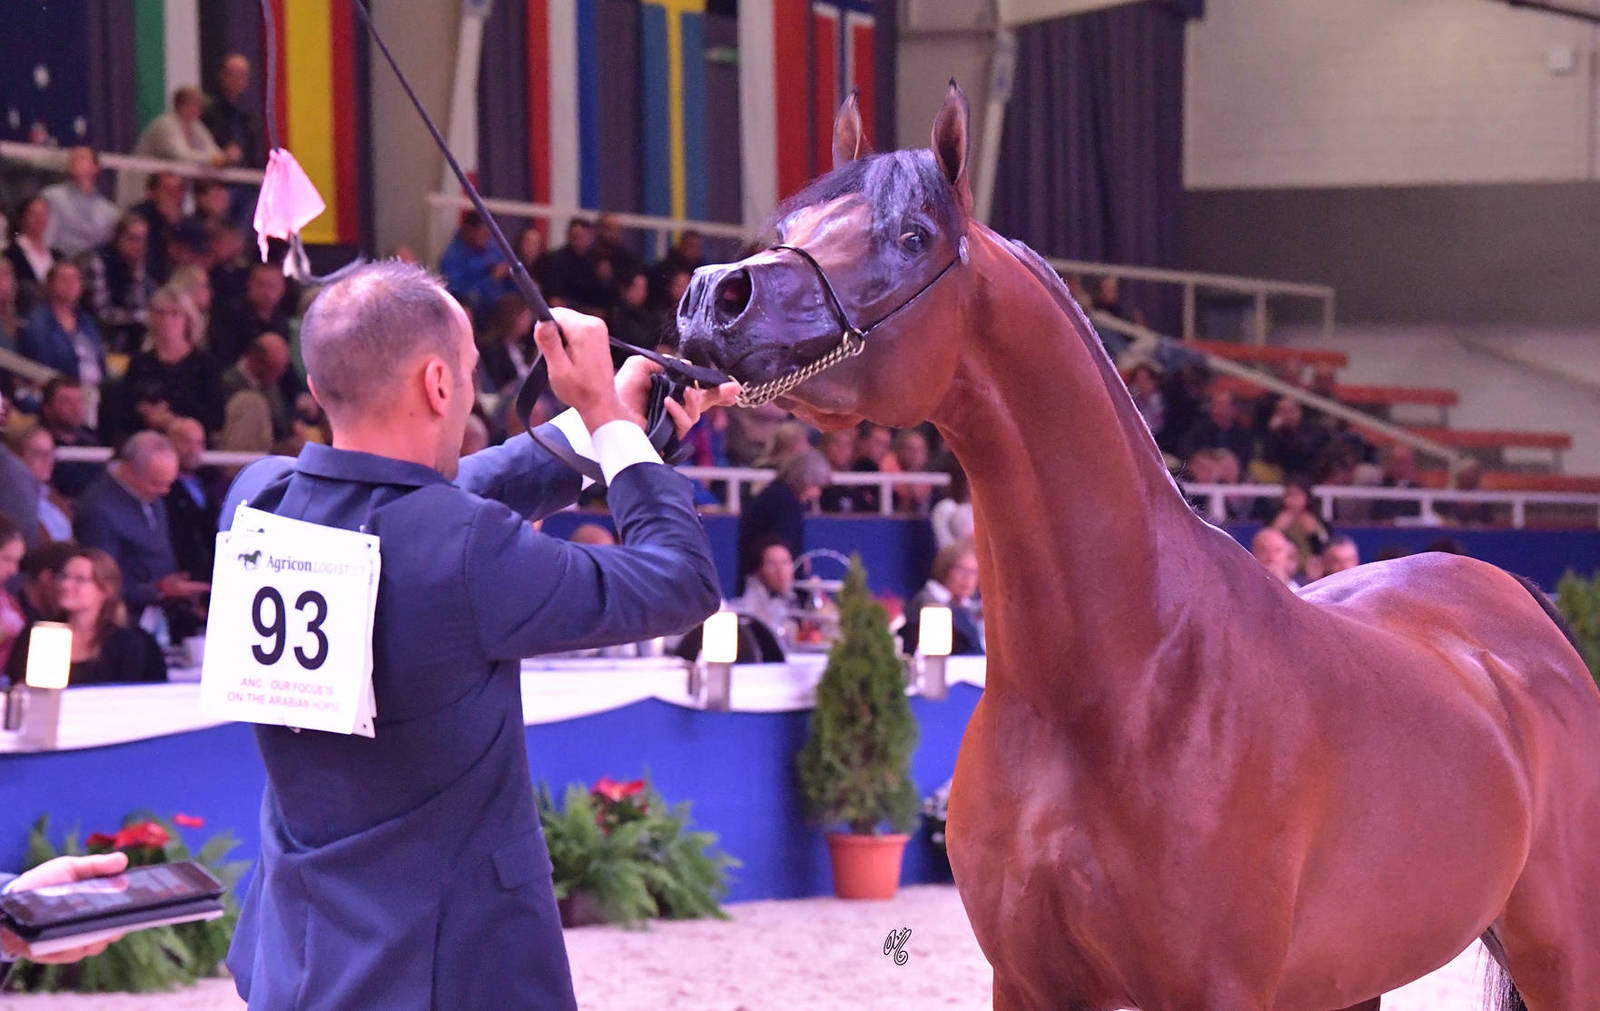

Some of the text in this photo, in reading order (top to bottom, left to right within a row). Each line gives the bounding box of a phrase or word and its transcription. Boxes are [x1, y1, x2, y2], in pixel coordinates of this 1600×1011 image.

[251, 586, 328, 670] 93
[271, 680, 291, 691] OUR
[293, 682, 323, 696] FOCUS
[226, 690, 243, 702] ON
[247, 693, 266, 704] THE
[269, 695, 310, 709] ARABIAN
